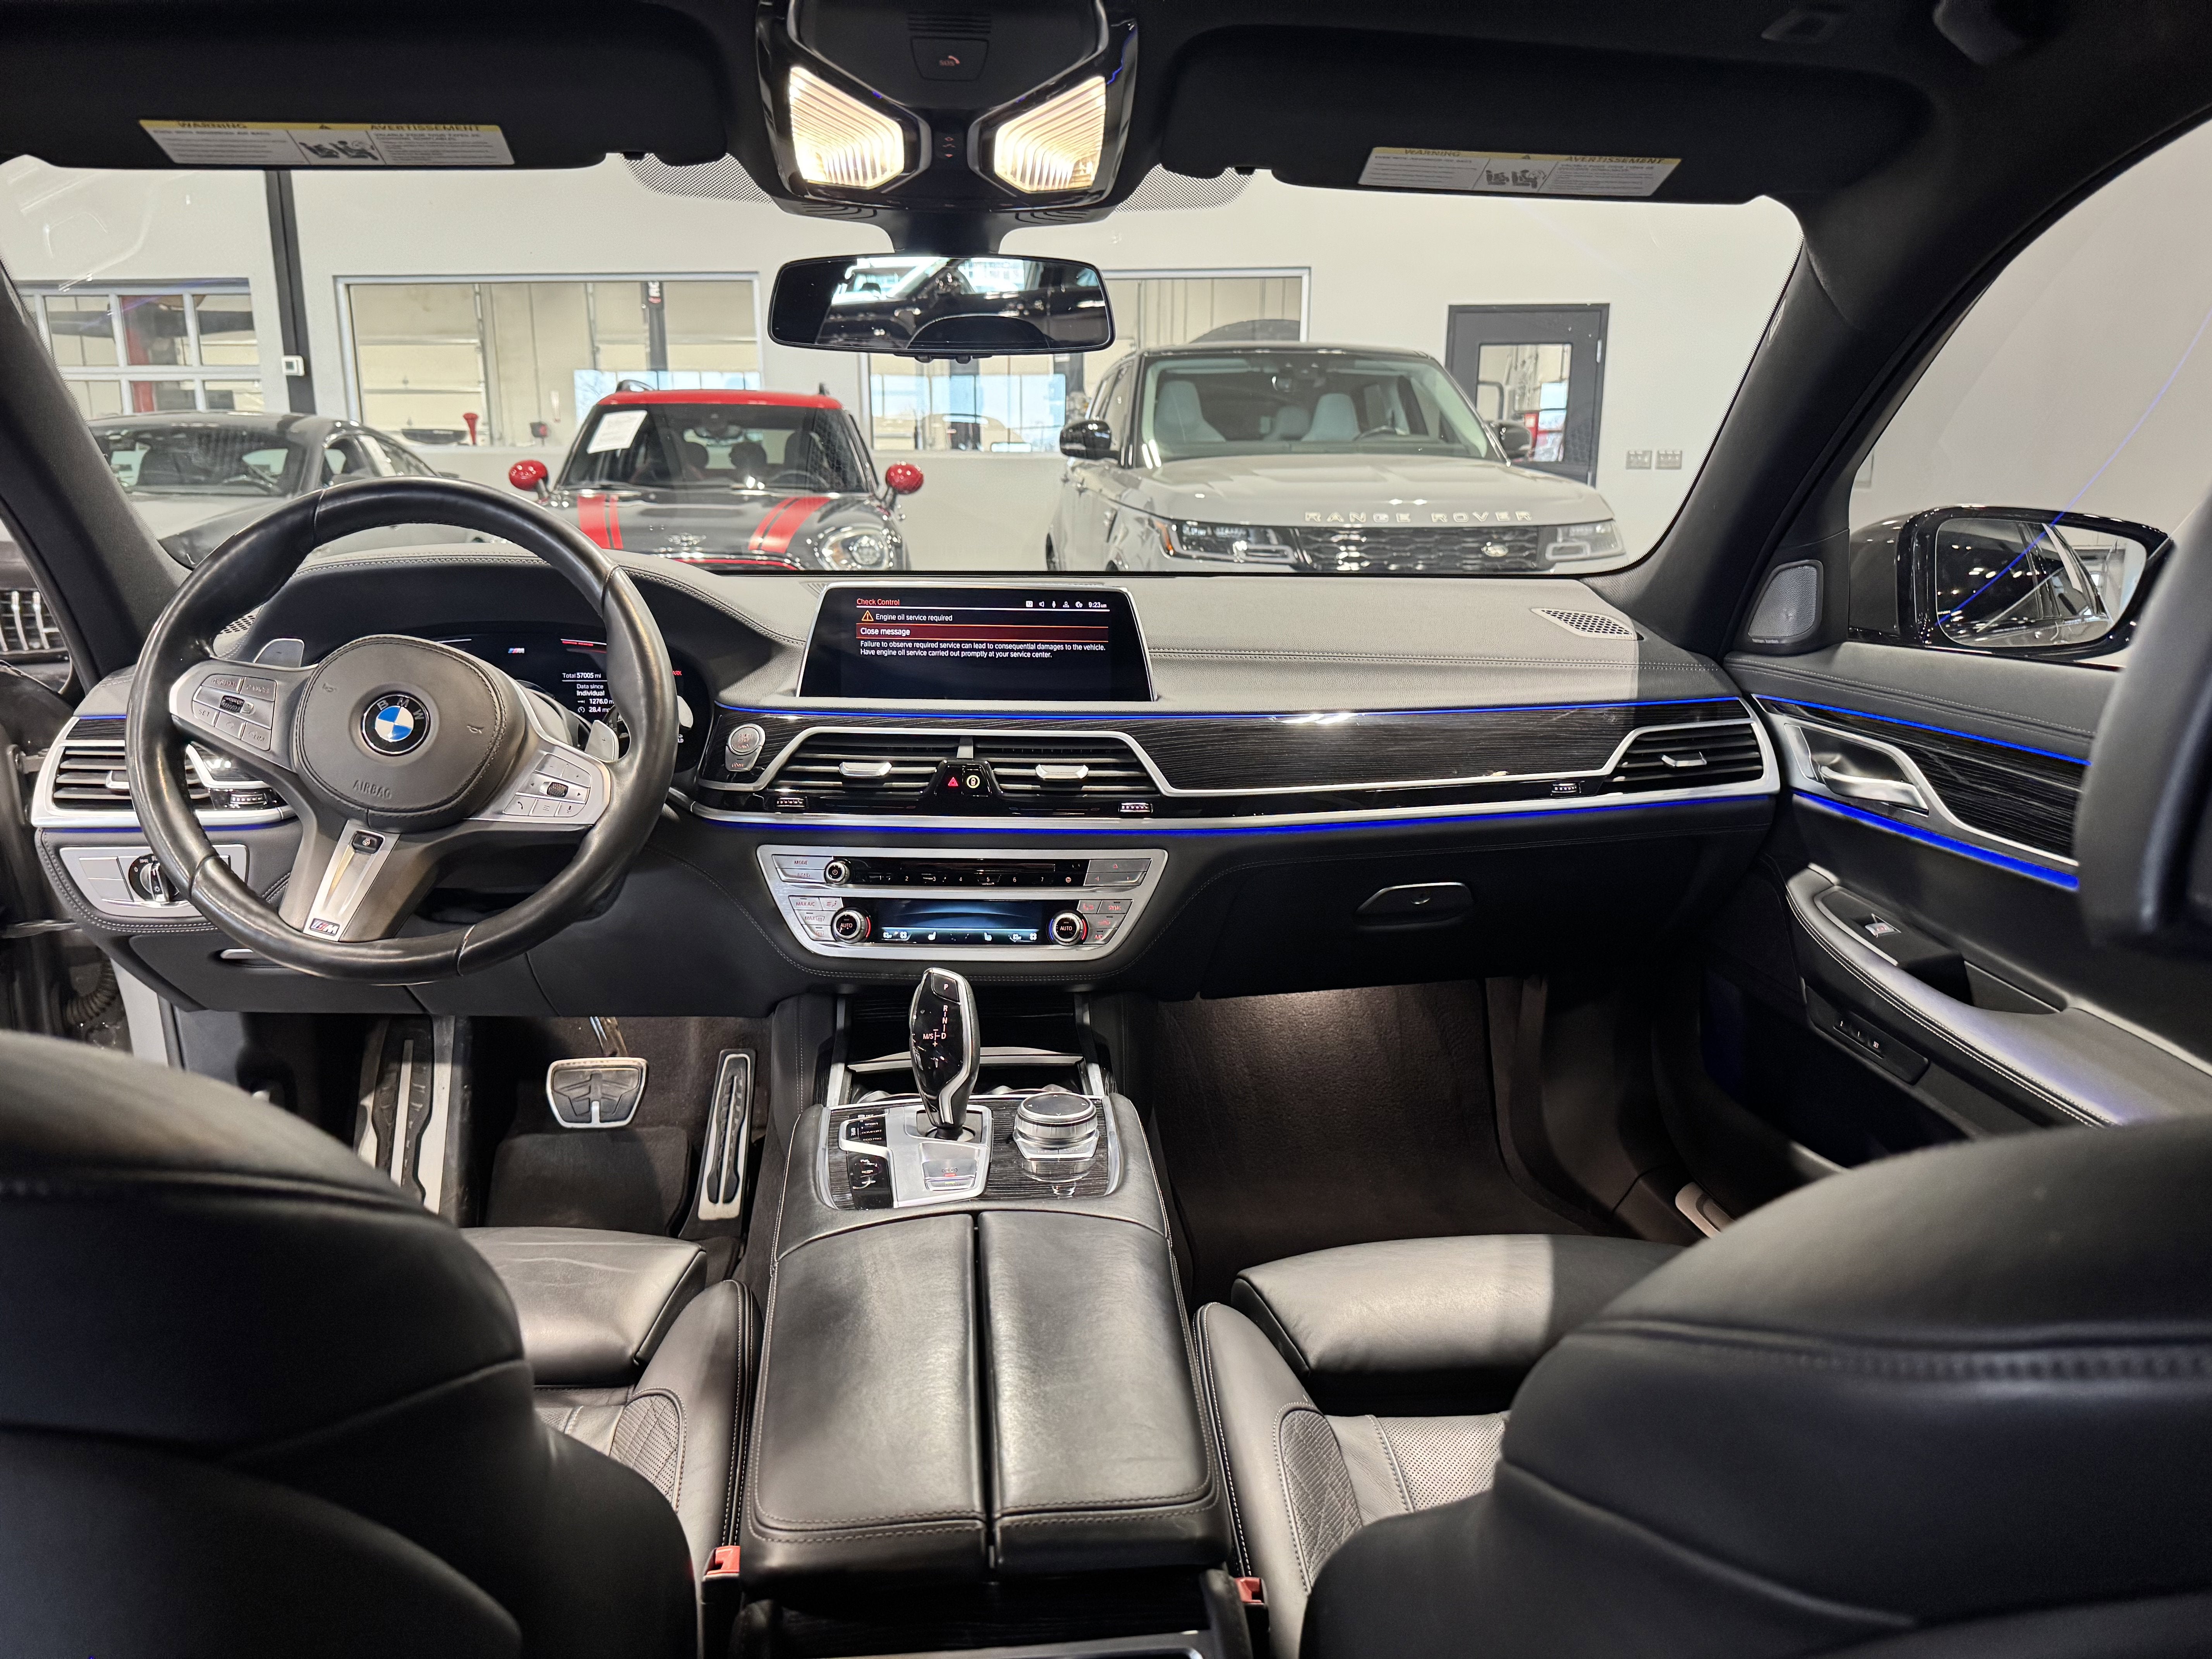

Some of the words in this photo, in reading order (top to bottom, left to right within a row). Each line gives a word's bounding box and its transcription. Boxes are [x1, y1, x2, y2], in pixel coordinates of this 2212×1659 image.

[1405, 149, 1460, 157] WARNING
[1566, 155, 1665, 164] AVERTISSEMENT
[1305, 512, 1411, 523] RANGE
[1431, 511, 1533, 523] ROVER
[876, 613, 896, 622] Engine
[880, 629, 910, 637] message
[914, 642, 938, 650] required
[995, 643, 1036, 651] consequential
[1037, 643, 1064, 651] damages
[198, 709, 210, 717] SET
[376, 697, 424, 720] BMW
[353, 780, 392, 800] AIRBAG
